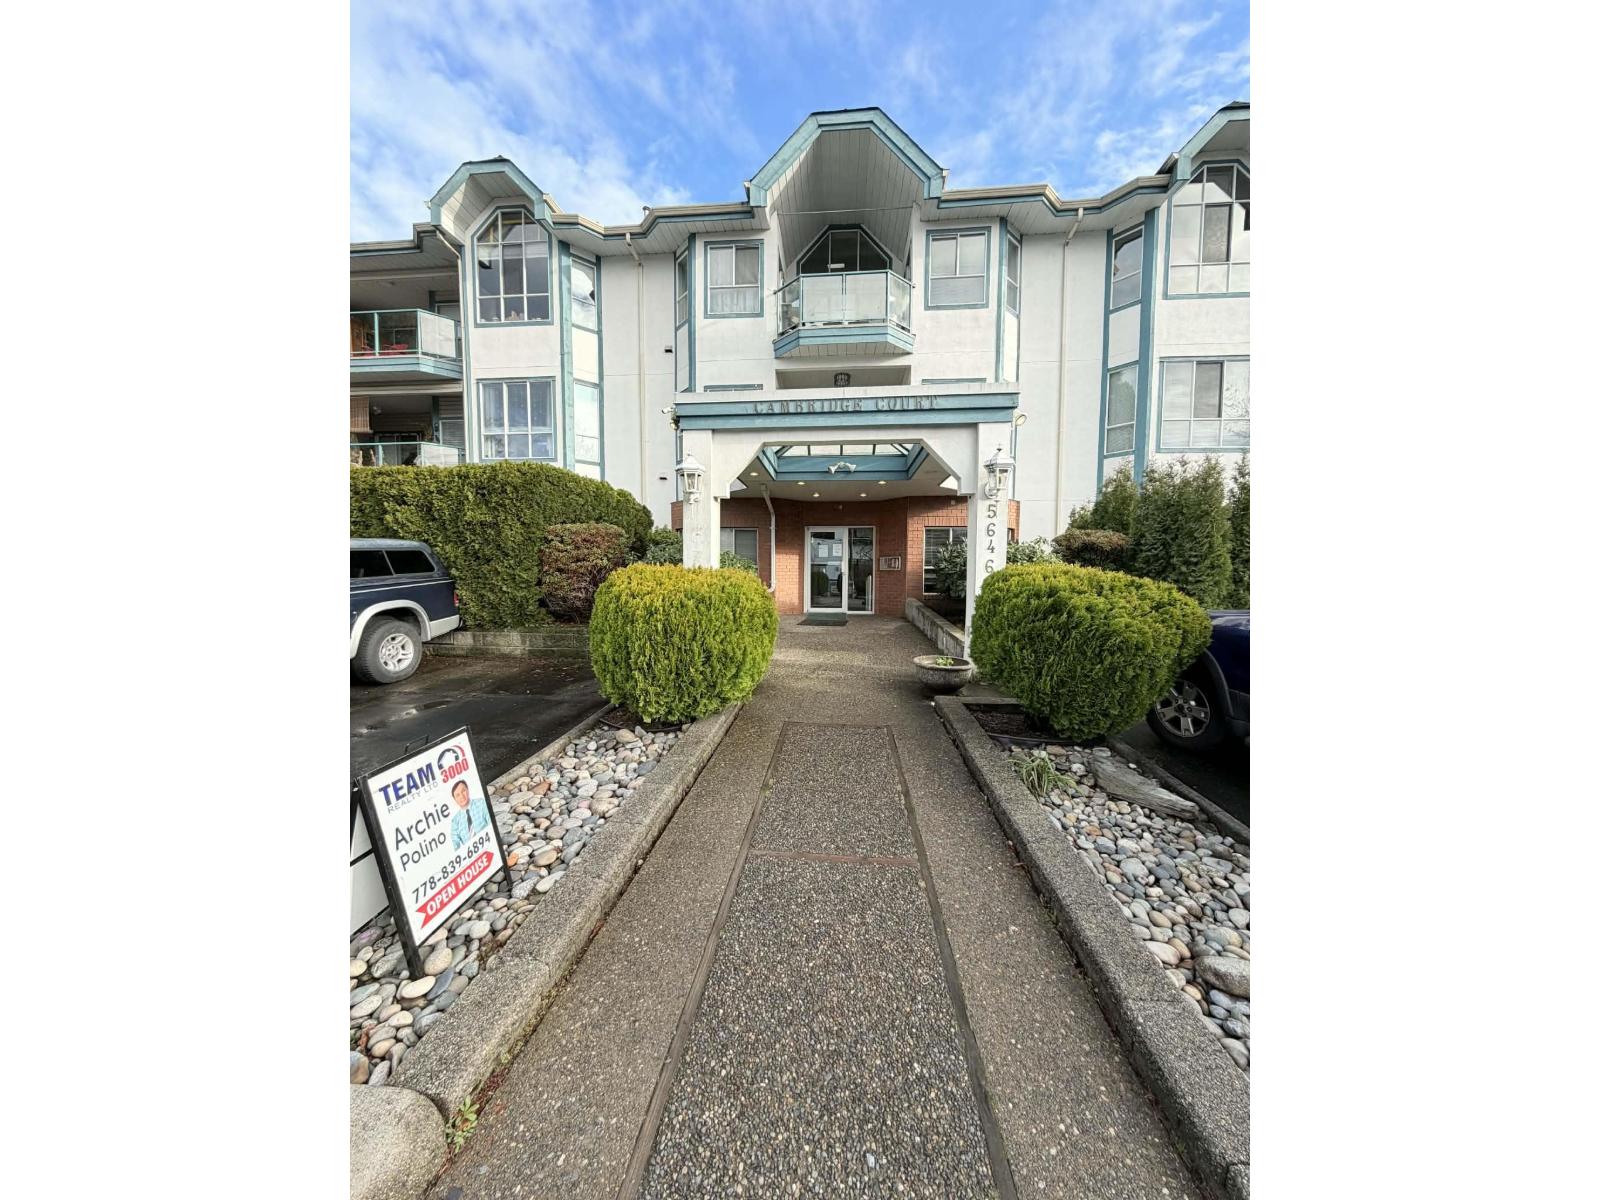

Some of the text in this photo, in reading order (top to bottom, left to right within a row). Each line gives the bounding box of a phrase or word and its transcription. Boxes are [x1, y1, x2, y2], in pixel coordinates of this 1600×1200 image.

[754, 395, 937, 414] CAMBRIDGE COURT
[985, 503, 997, 574] 5646
[379, 757, 469, 806] TEAM 3000
[395, 803, 450, 850] Archie
[400, 831, 447, 872] Polino
[412, 831, 491, 904] 778-839-6894
[426, 858, 489, 916] OPEN HOUSE
